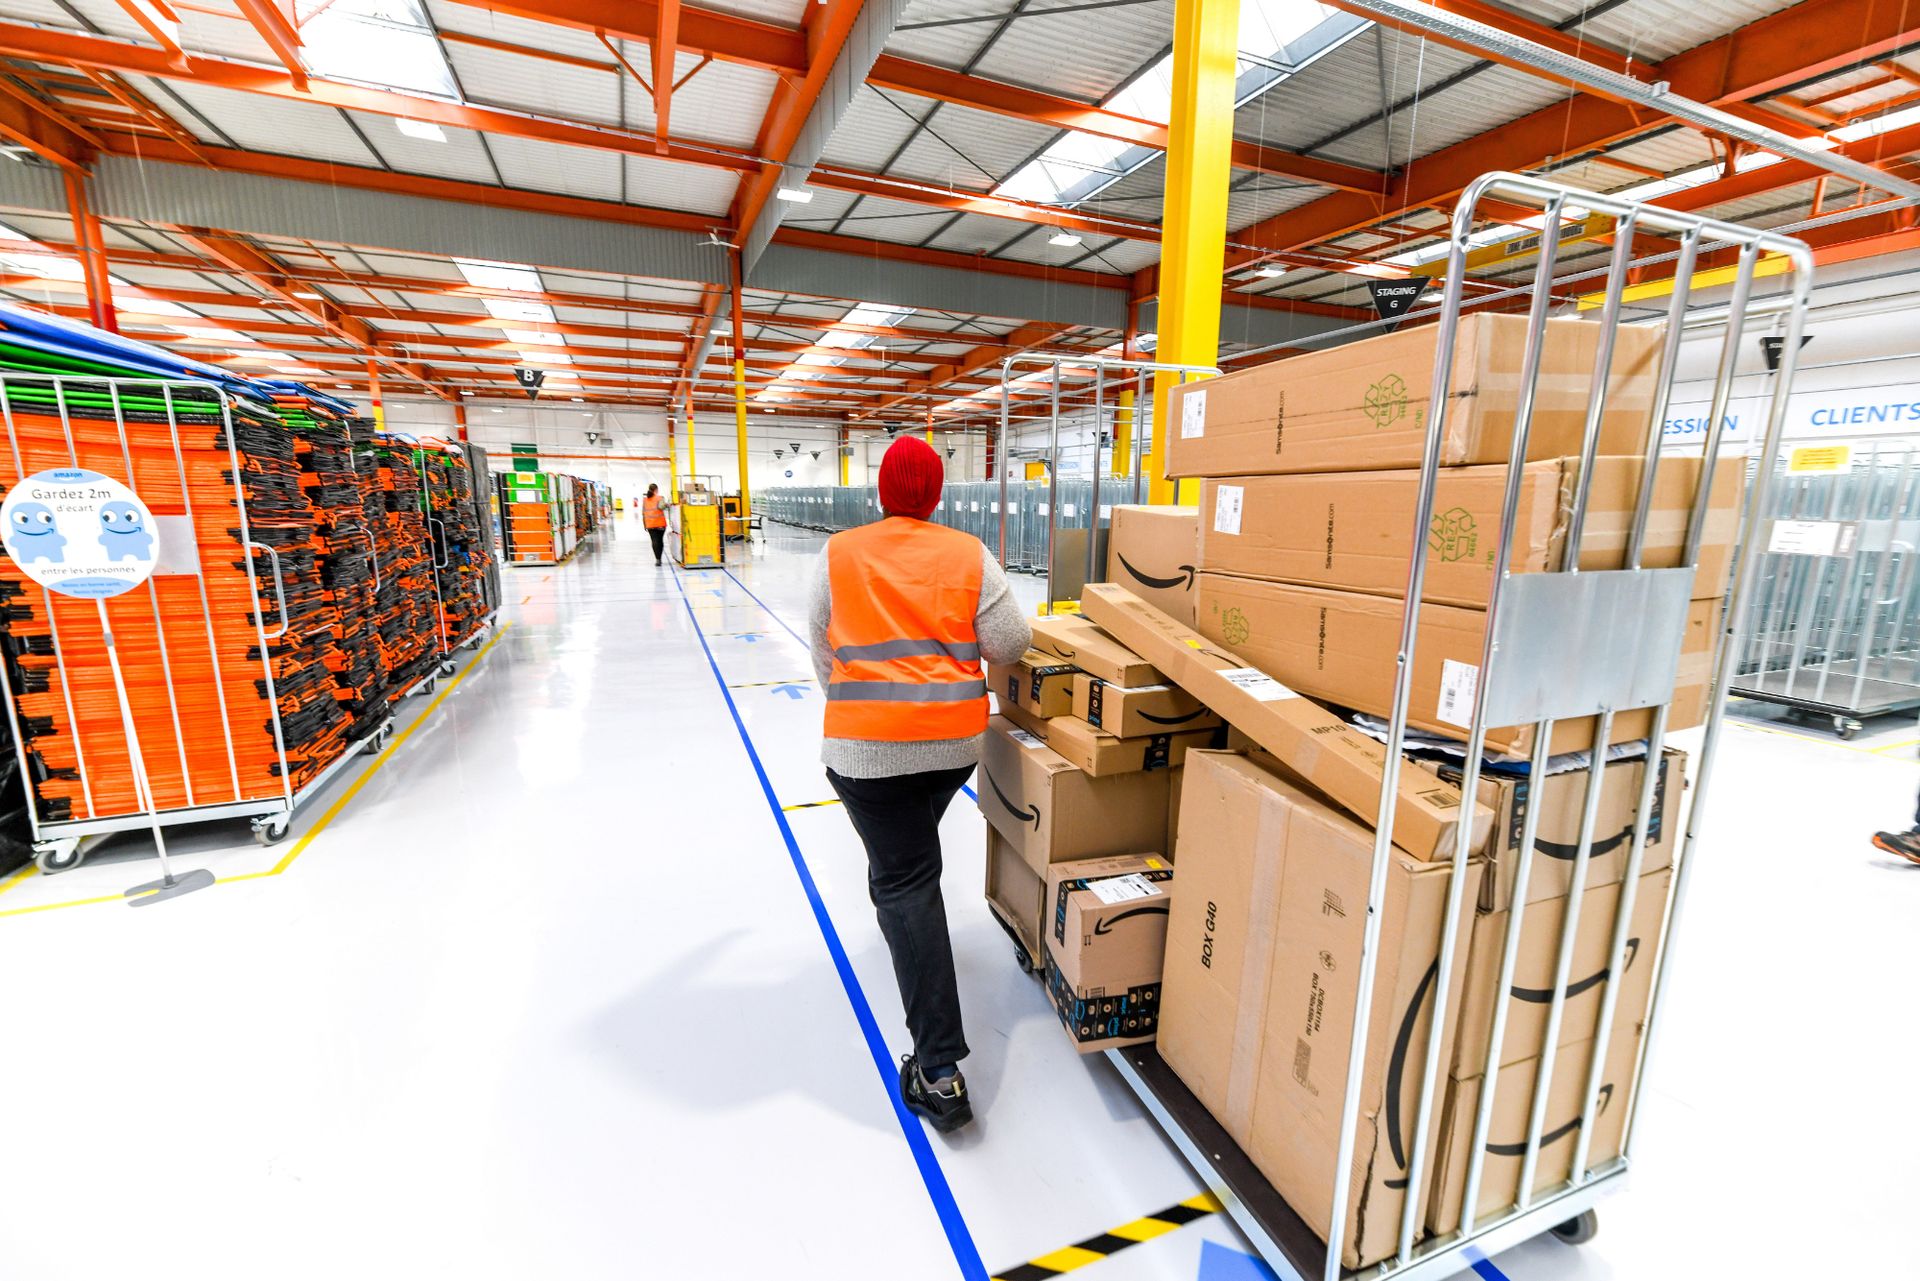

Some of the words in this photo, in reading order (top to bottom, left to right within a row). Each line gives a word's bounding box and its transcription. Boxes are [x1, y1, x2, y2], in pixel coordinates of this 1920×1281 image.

[1376, 286, 1417, 297] STAGING
[1389, 300, 1399, 308] G
[523, 370, 535, 382] B
[1811, 402, 1920, 426] CLIENTS
[31, 488, 84, 500] Gardez
[88, 488, 112, 500] 2m
[41, 567, 67, 576] entre
[70, 566, 84, 575] les
[86, 565, 136, 576] personnes
[1310, 724, 1348, 735] MP10
[1206, 900, 1217, 932] G40
[1201, 932, 1214, 970] BOX
[1311, 972, 1319, 990] BOX
